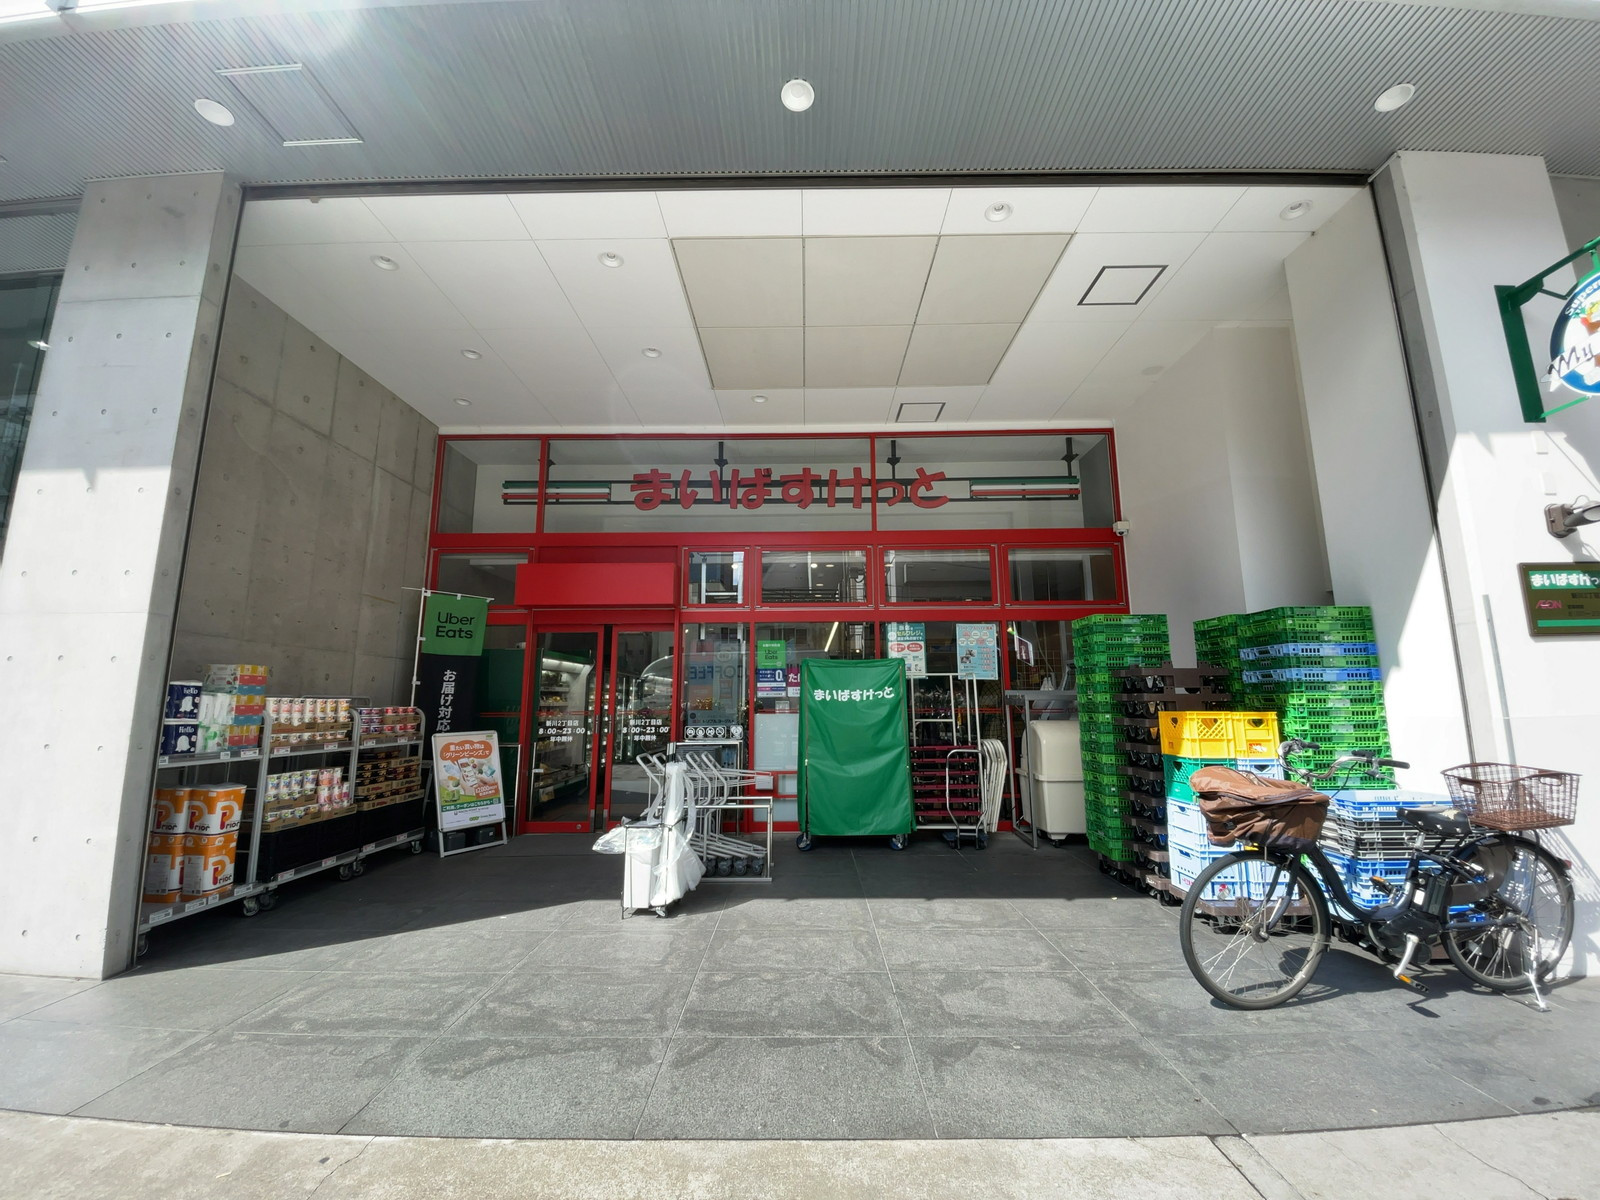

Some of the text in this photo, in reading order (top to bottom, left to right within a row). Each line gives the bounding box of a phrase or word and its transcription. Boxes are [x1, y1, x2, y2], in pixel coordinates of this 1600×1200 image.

[1565, 280, 1600, 316] Super
[1548, 344, 1595, 378] My
[630, 466, 949, 511] まいばすけっと
[1530, 573, 1600, 588] まいばすけっ
[437, 611, 475, 626] Uber
[435, 625, 473, 640] Eats
[436, 669, 457, 733] お届け対応
[814, 687, 895, 702] まいばすけっと
[153, 804, 178, 830] Prior
[188, 804, 211, 831] Prior
[219, 804, 240, 830] Prior
[211, 860, 232, 886] Prior
